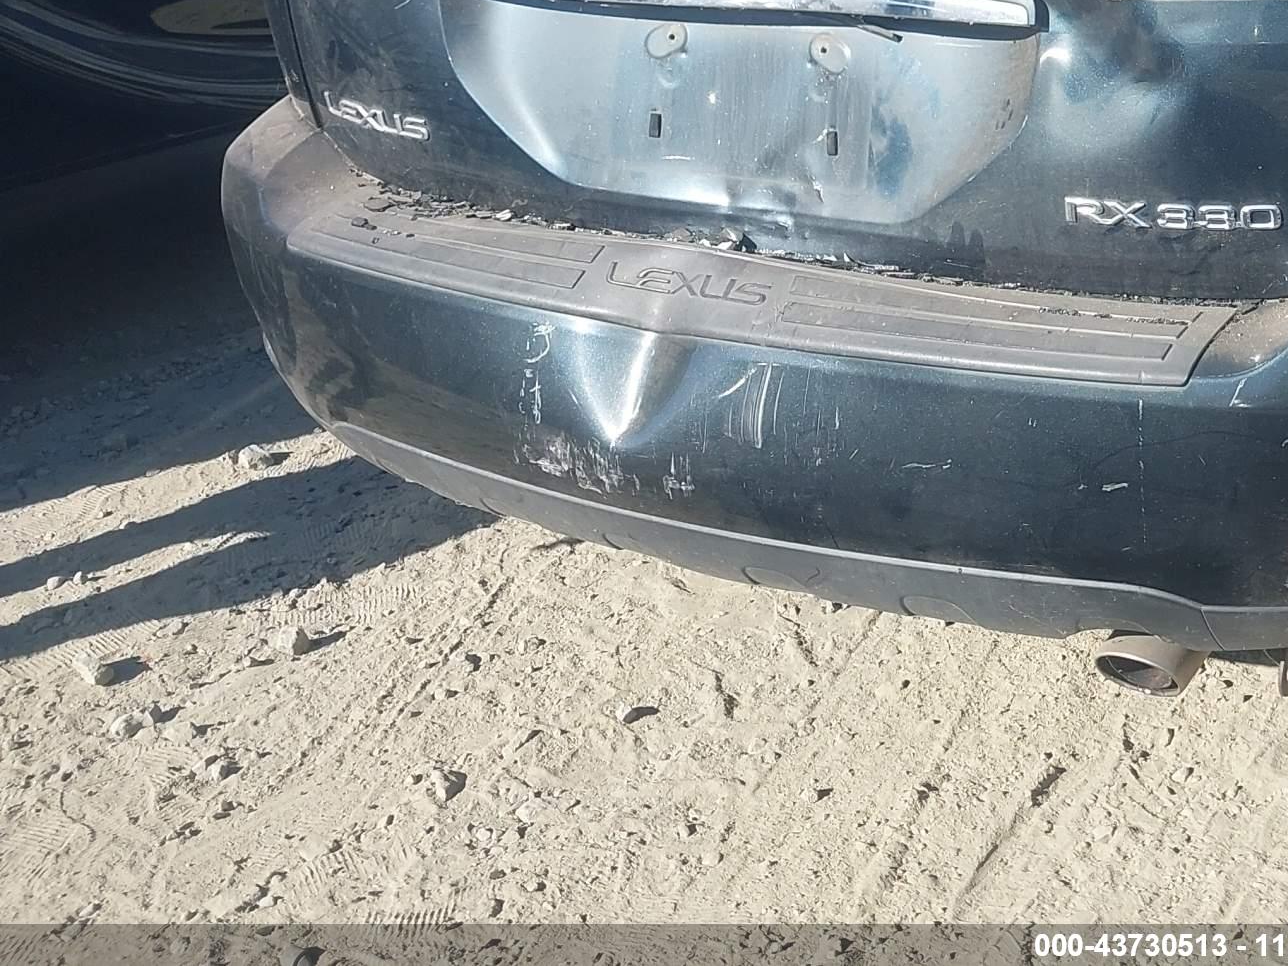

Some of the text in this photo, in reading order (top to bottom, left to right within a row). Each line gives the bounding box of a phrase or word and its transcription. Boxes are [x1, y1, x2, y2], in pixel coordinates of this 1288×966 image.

[324, 90, 430, 141] LEXUS
[1064, 195, 1283, 231] RX 330
[605, 260, 773, 306] LEXUS
